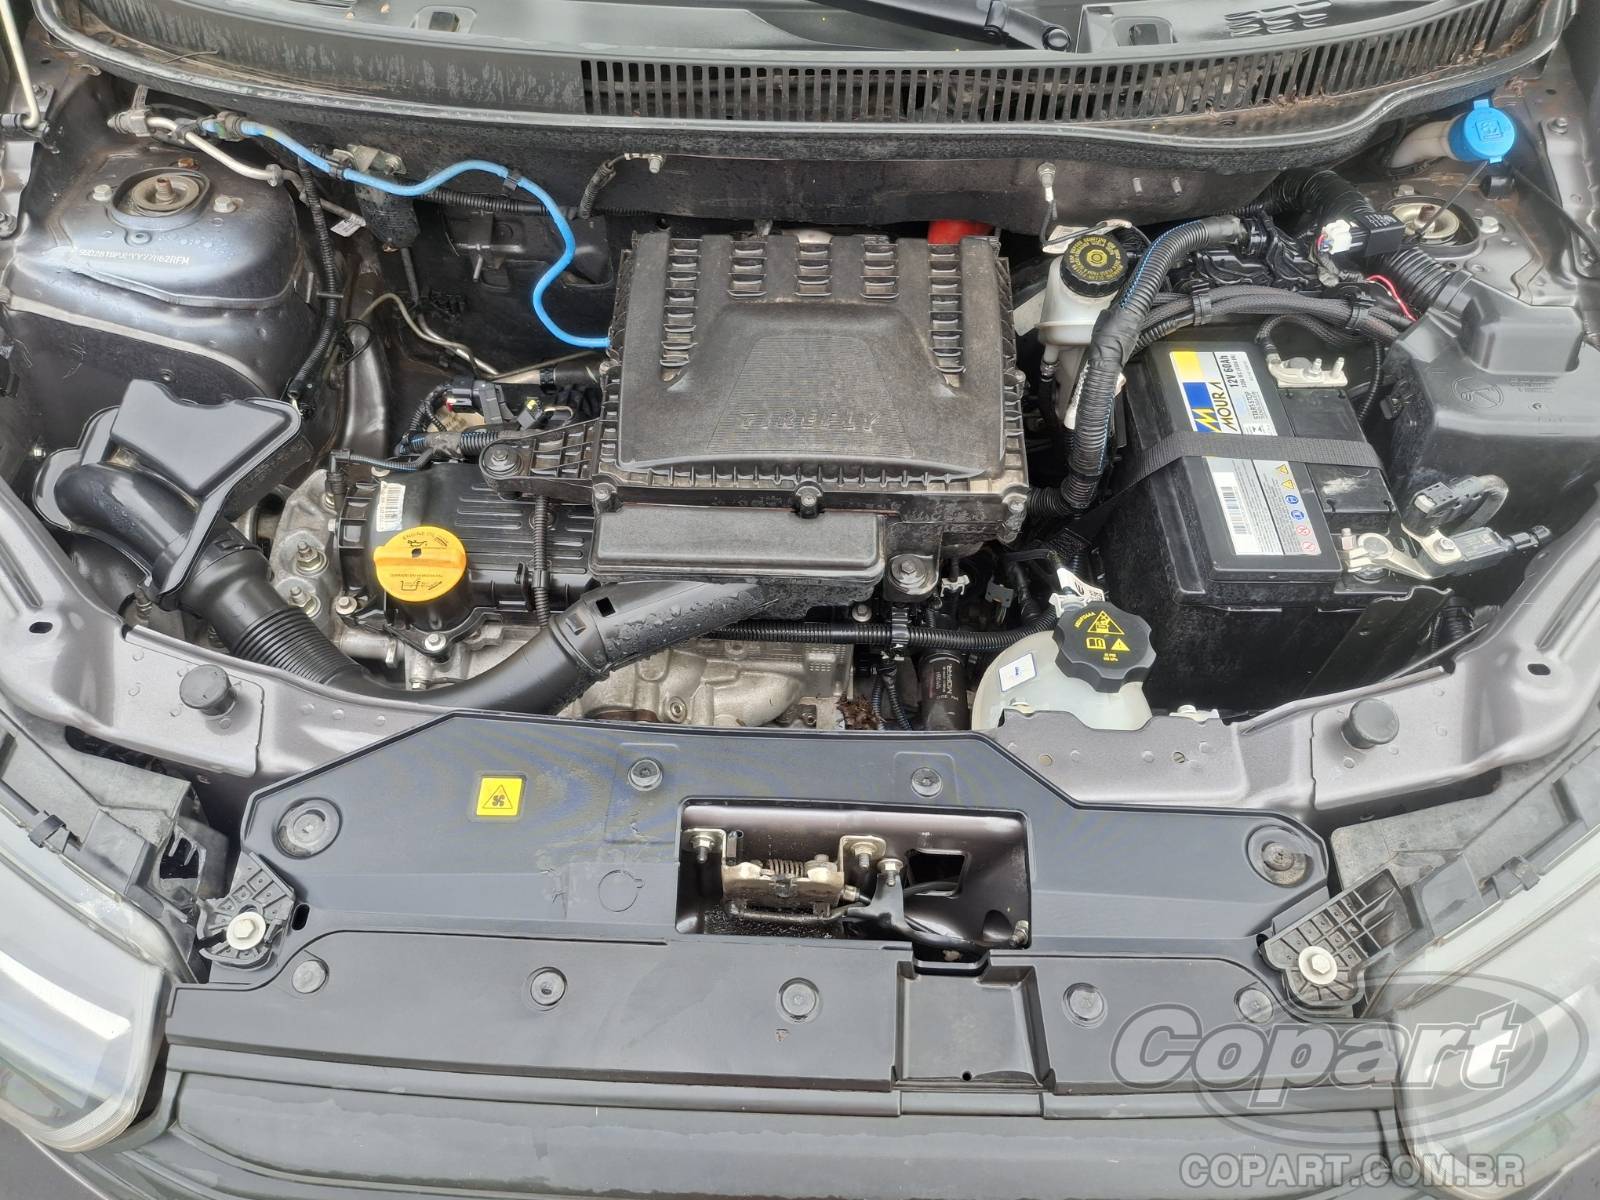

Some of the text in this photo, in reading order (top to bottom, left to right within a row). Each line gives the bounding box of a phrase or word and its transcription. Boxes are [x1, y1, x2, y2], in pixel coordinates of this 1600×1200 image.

[1219, 354, 1234, 373] 60Ah
[1224, 374, 1239, 388] 12V
[1208, 381, 1238, 432] MOURA
